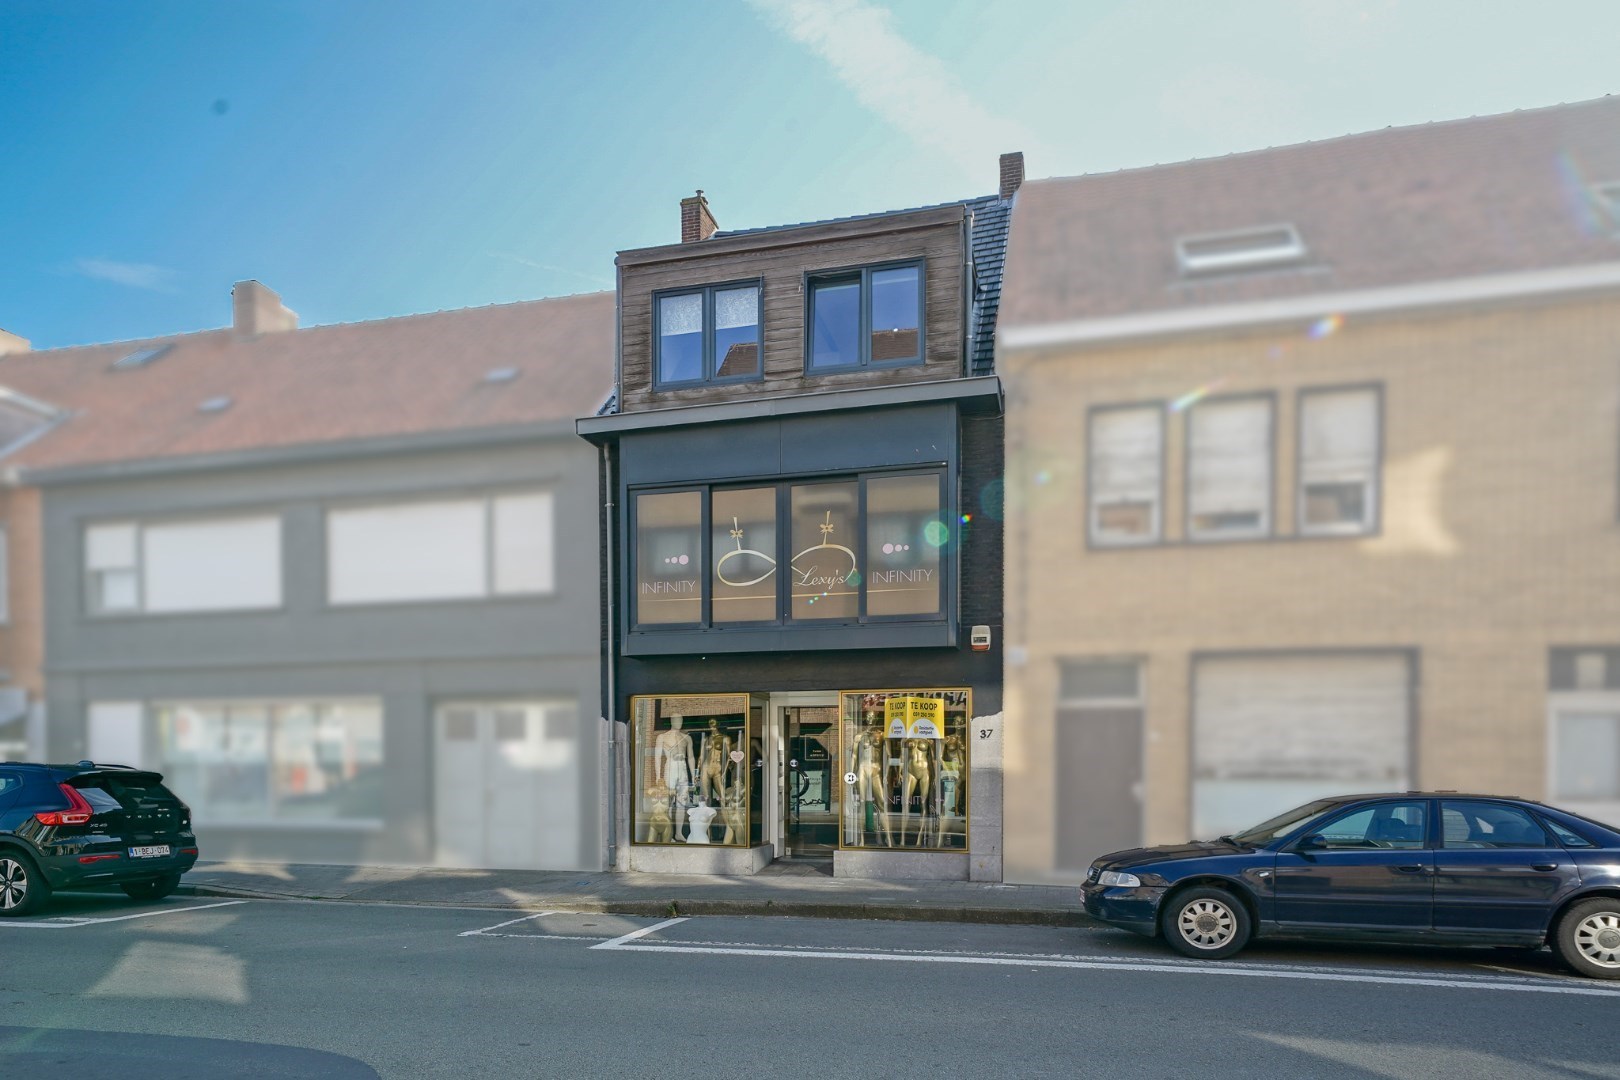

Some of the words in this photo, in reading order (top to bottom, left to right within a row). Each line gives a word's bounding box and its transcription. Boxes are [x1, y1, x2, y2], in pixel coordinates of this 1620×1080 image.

[793, 565, 845, 590] Lexy's
[872, 569, 933, 584] INFINITY
[642, 580, 696, 594] INFINITY
[911, 702, 919, 710] TE
[920, 702, 938, 711] KOOP
[980, 729, 993, 739] 37
